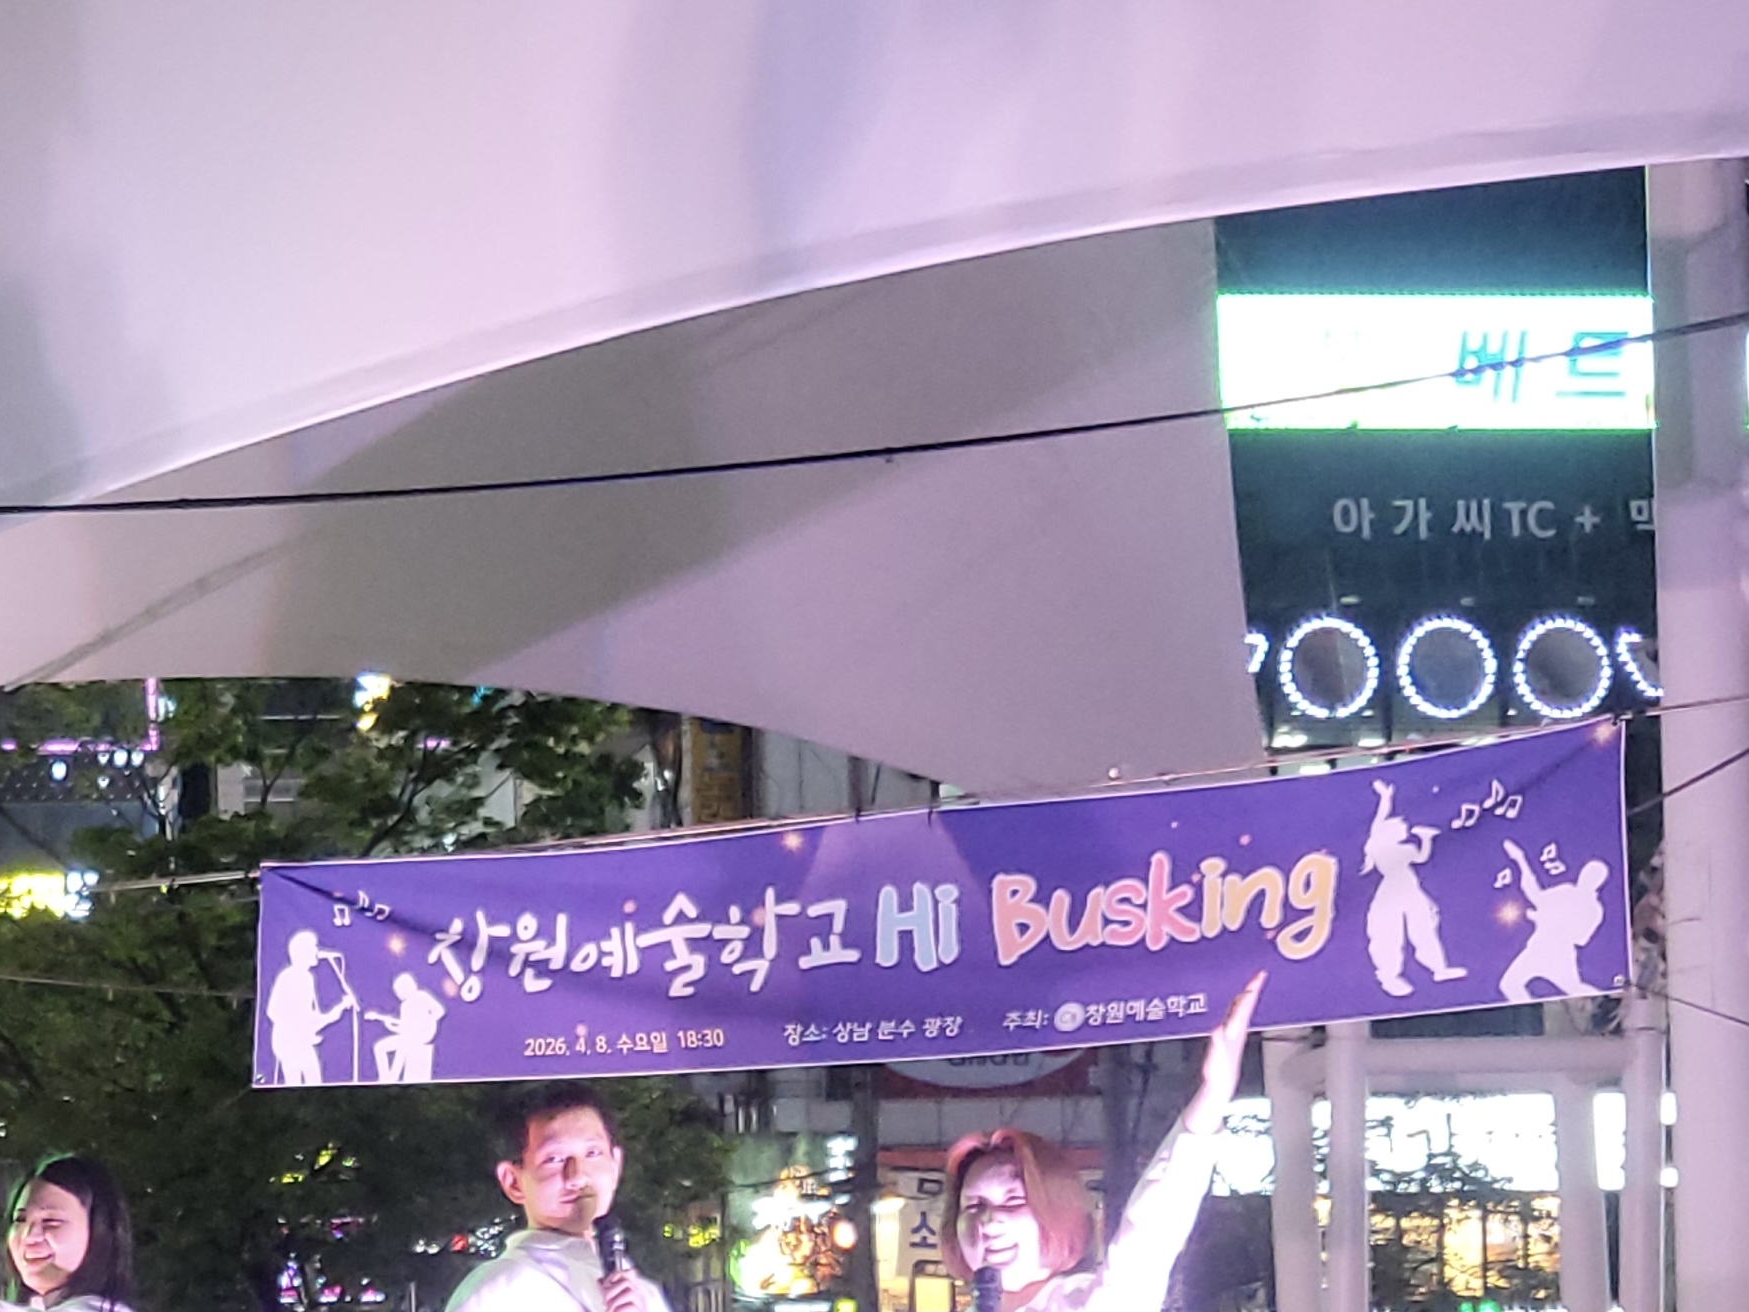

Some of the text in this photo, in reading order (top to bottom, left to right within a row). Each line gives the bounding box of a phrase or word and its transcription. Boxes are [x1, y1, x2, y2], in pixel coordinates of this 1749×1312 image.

[427, 849, 1339, 1003] 창원예술학교 Hi Busking
[1002, 992, 1208, 1032] 주최: 창원예술학교
[616, 1031, 668, 1055] 수요일
[677, 1028, 725, 1049] 18:30
[783, 1015, 963, 1047] 장소: 상남 분수 광장
